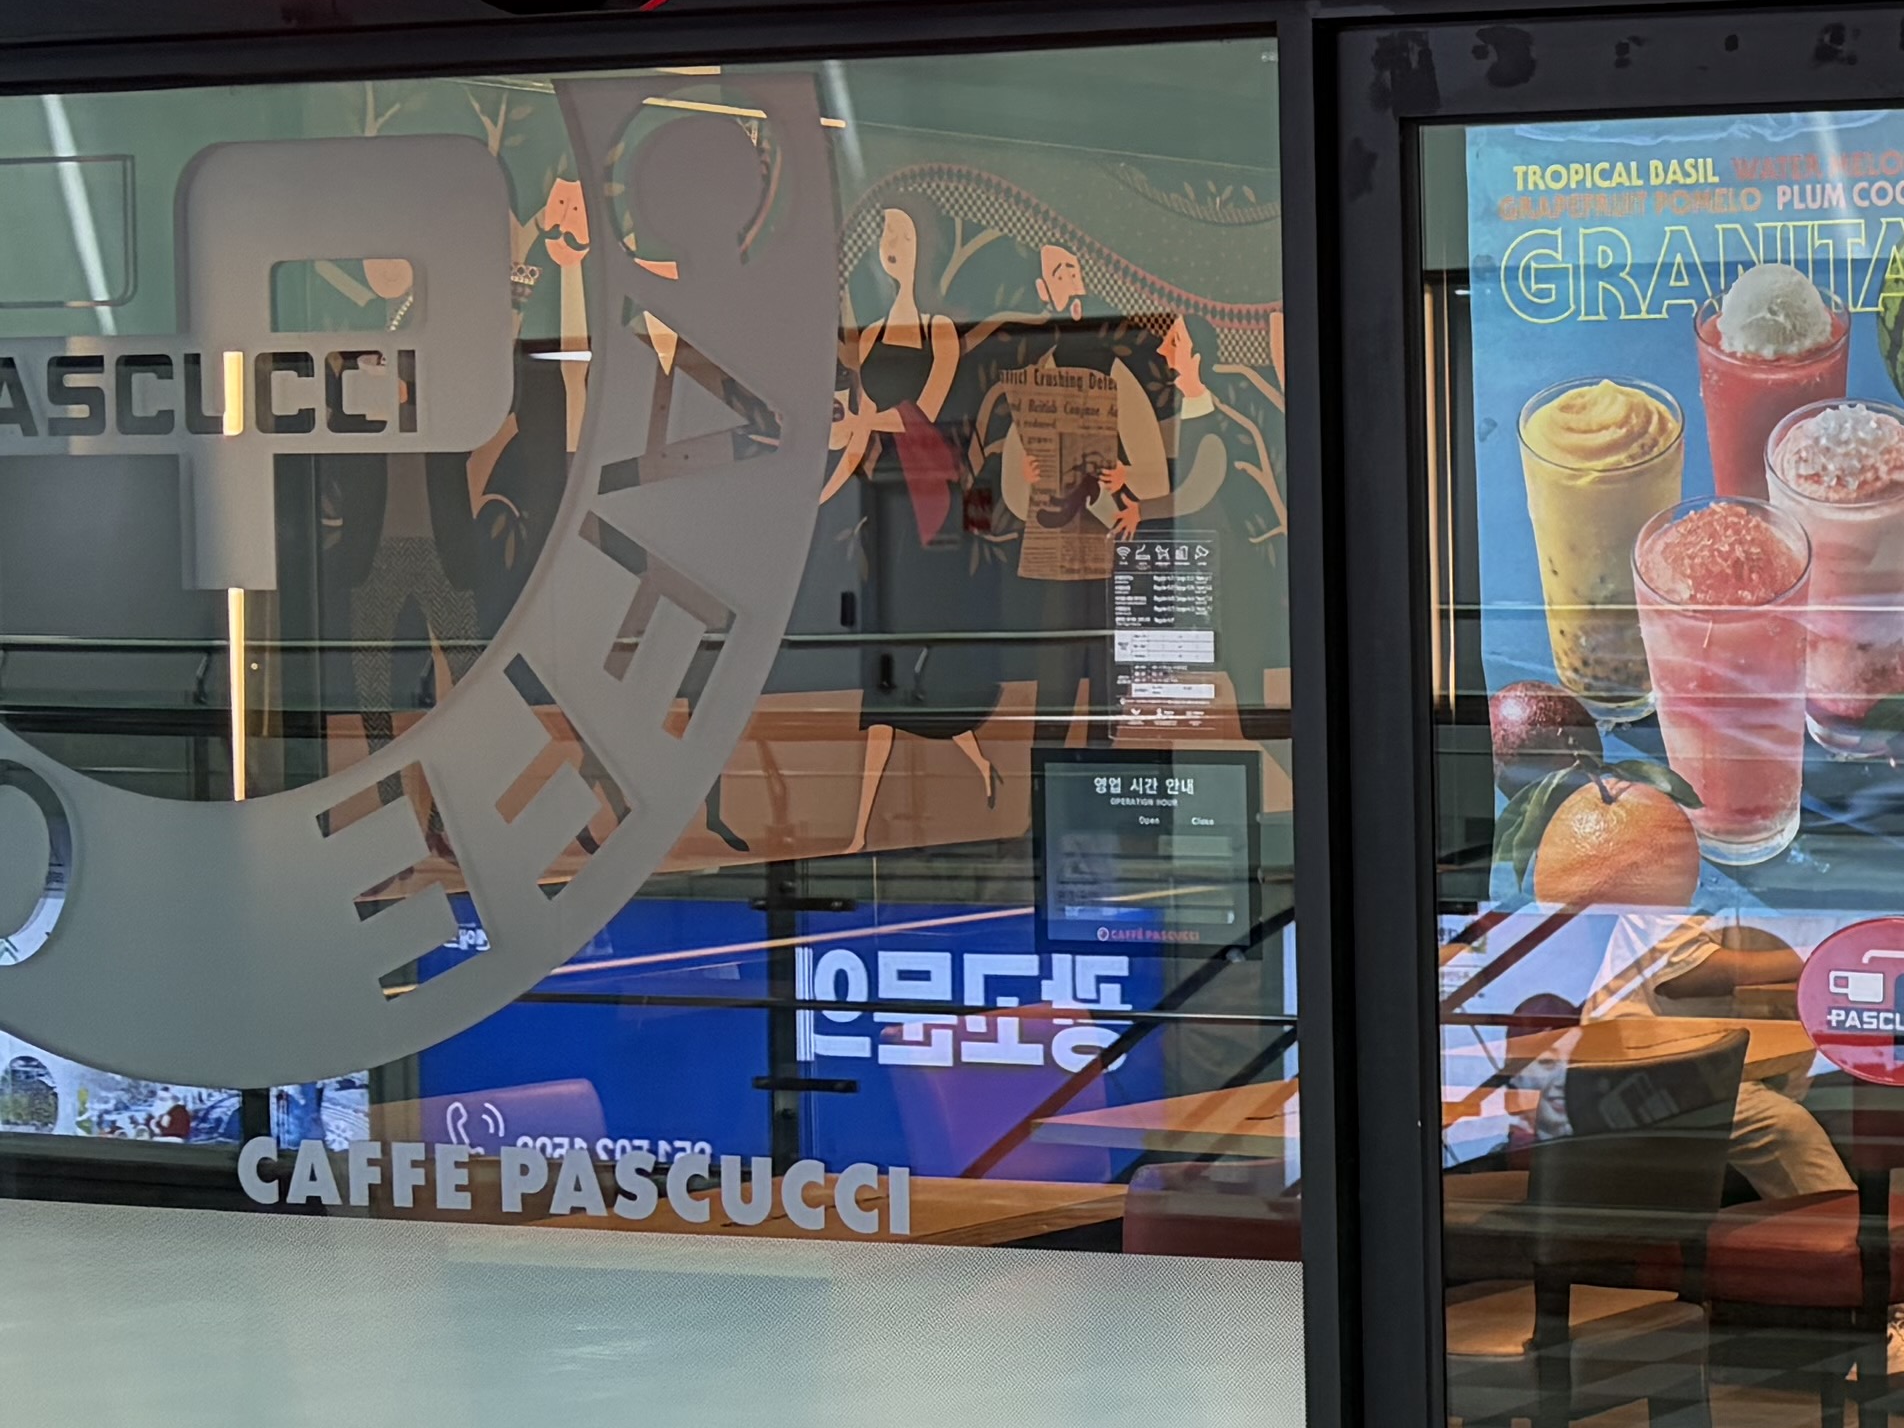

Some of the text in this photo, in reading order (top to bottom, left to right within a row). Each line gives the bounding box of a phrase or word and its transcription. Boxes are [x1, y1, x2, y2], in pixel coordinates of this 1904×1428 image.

[1513, 162, 1643, 191] TROPICAL
[1649, 157, 1720, 185] BASIL
[1775, 183, 1847, 211] PLUM
[1093, 777, 1195, 796] 영업 시간 안내
[1110, 797, 1154, 807] OPERATION
[1138, 815, 1160, 826] Open
[237, 1135, 911, 1236] CAFFE PASCUCCI
